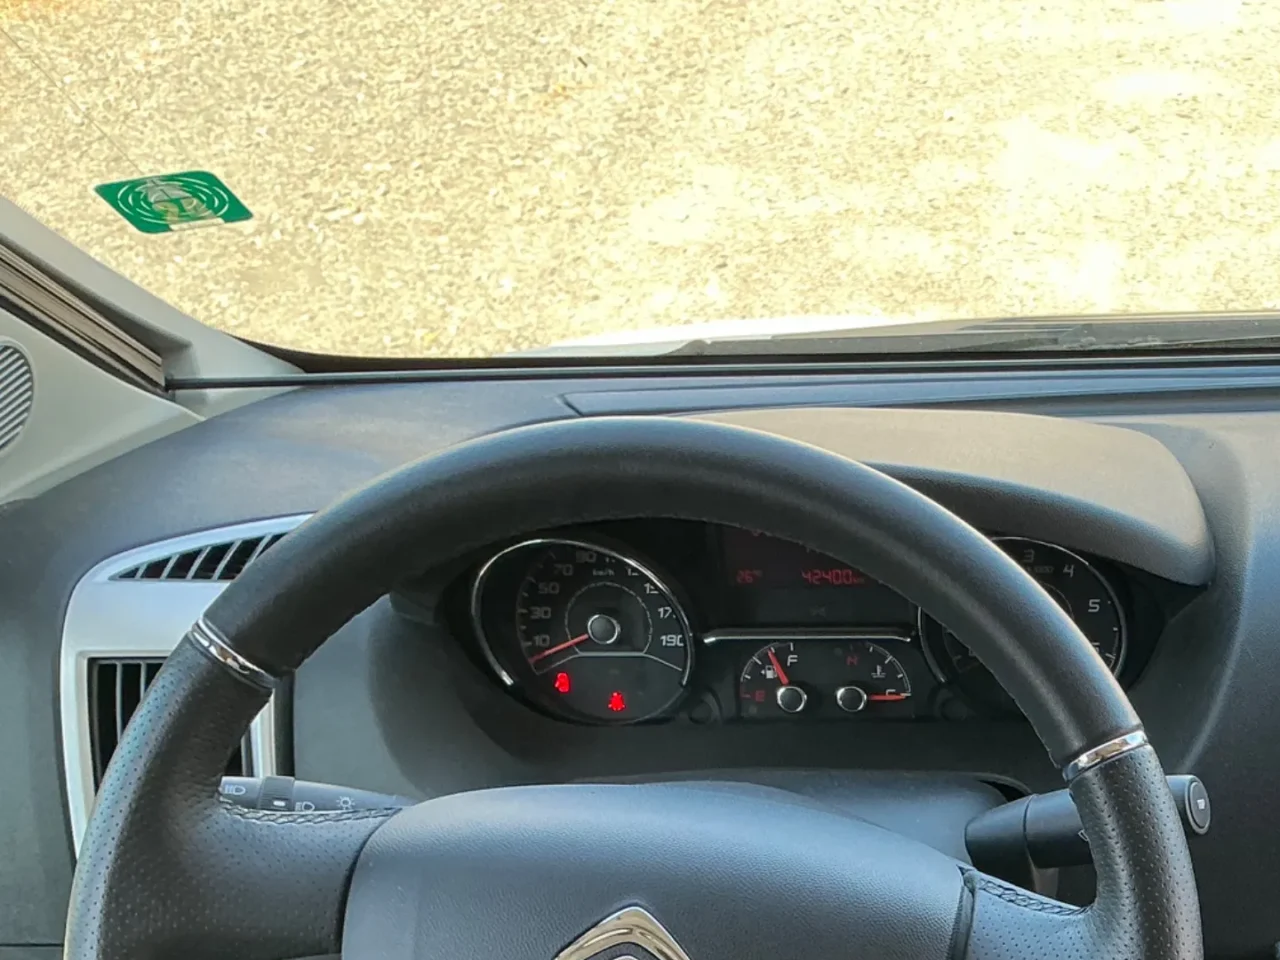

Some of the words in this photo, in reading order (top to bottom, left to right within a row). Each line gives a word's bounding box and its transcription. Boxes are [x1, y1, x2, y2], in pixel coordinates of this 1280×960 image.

[1023, 550, 1035, 563] 3
[553, 564, 573, 576] 70
[1063, 564, 1075, 577] 4
[538, 582, 560, 595] 50
[1088, 598, 1101, 613] 5
[530, 607, 551, 619] 30
[533, 635, 550, 647] 10
[787, 655, 798, 667] F
